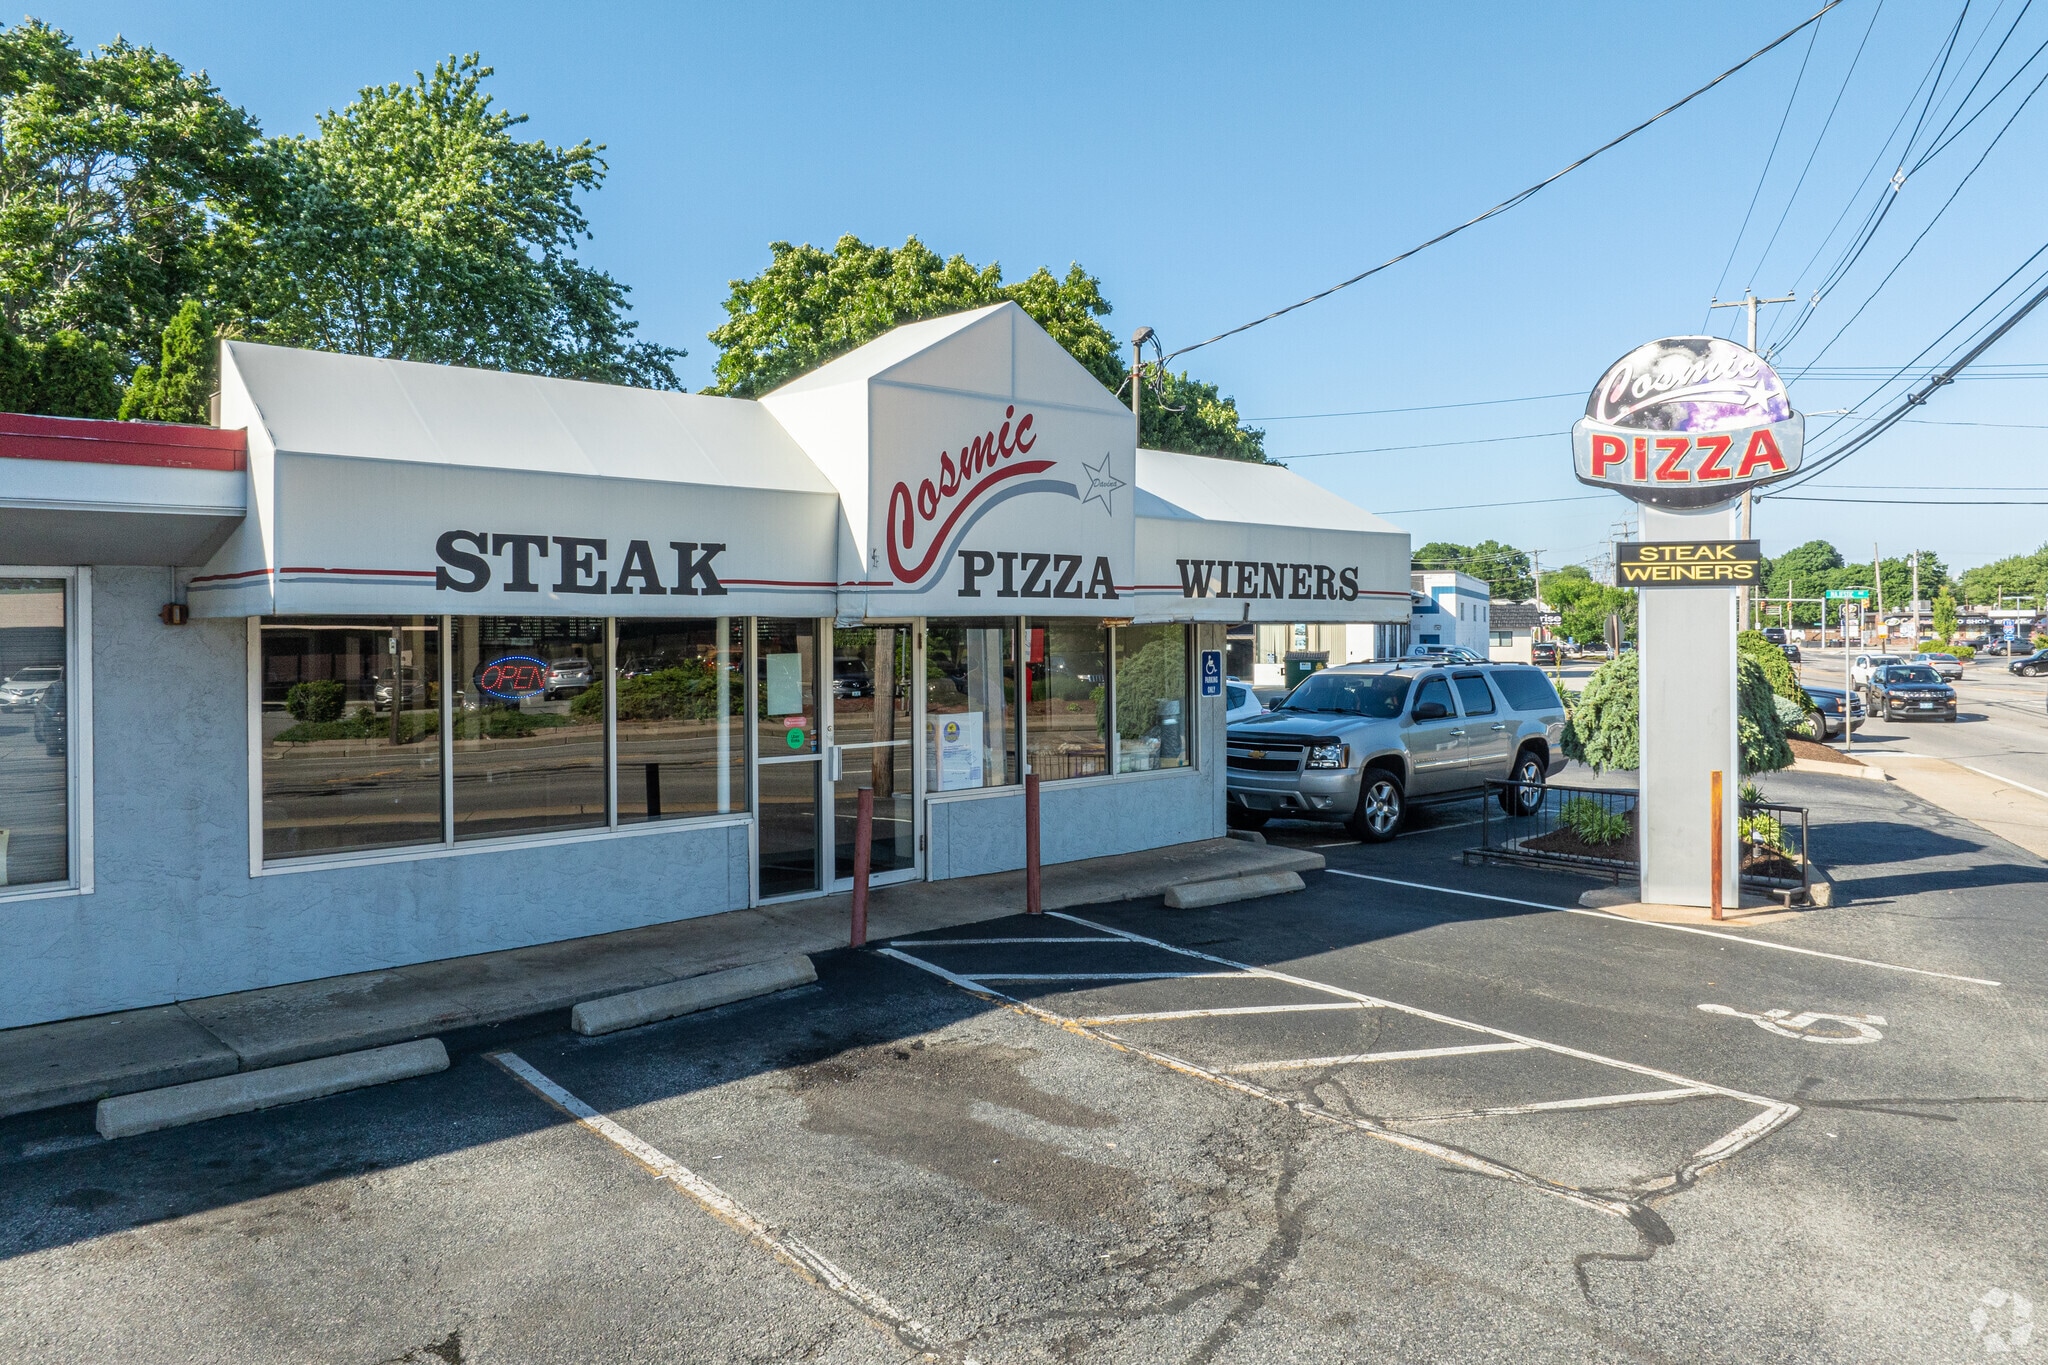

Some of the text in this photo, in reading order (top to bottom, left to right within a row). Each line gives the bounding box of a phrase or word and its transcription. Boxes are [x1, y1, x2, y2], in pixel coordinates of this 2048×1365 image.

[1597, 351, 1759, 426] Cosmic
[1590, 428, 1789, 483] PIZZA
[887, 404, 1037, 584] Cosmic
[435, 529, 728, 595] STEAK
[958, 550, 1119, 600] PIZZA
[1622, 564, 1754, 581] WEINERS
[1639, 545, 1736, 561] STEAK
[1176, 559, 1359, 602] WIENERS
[482, 665, 551, 689] OPEN
